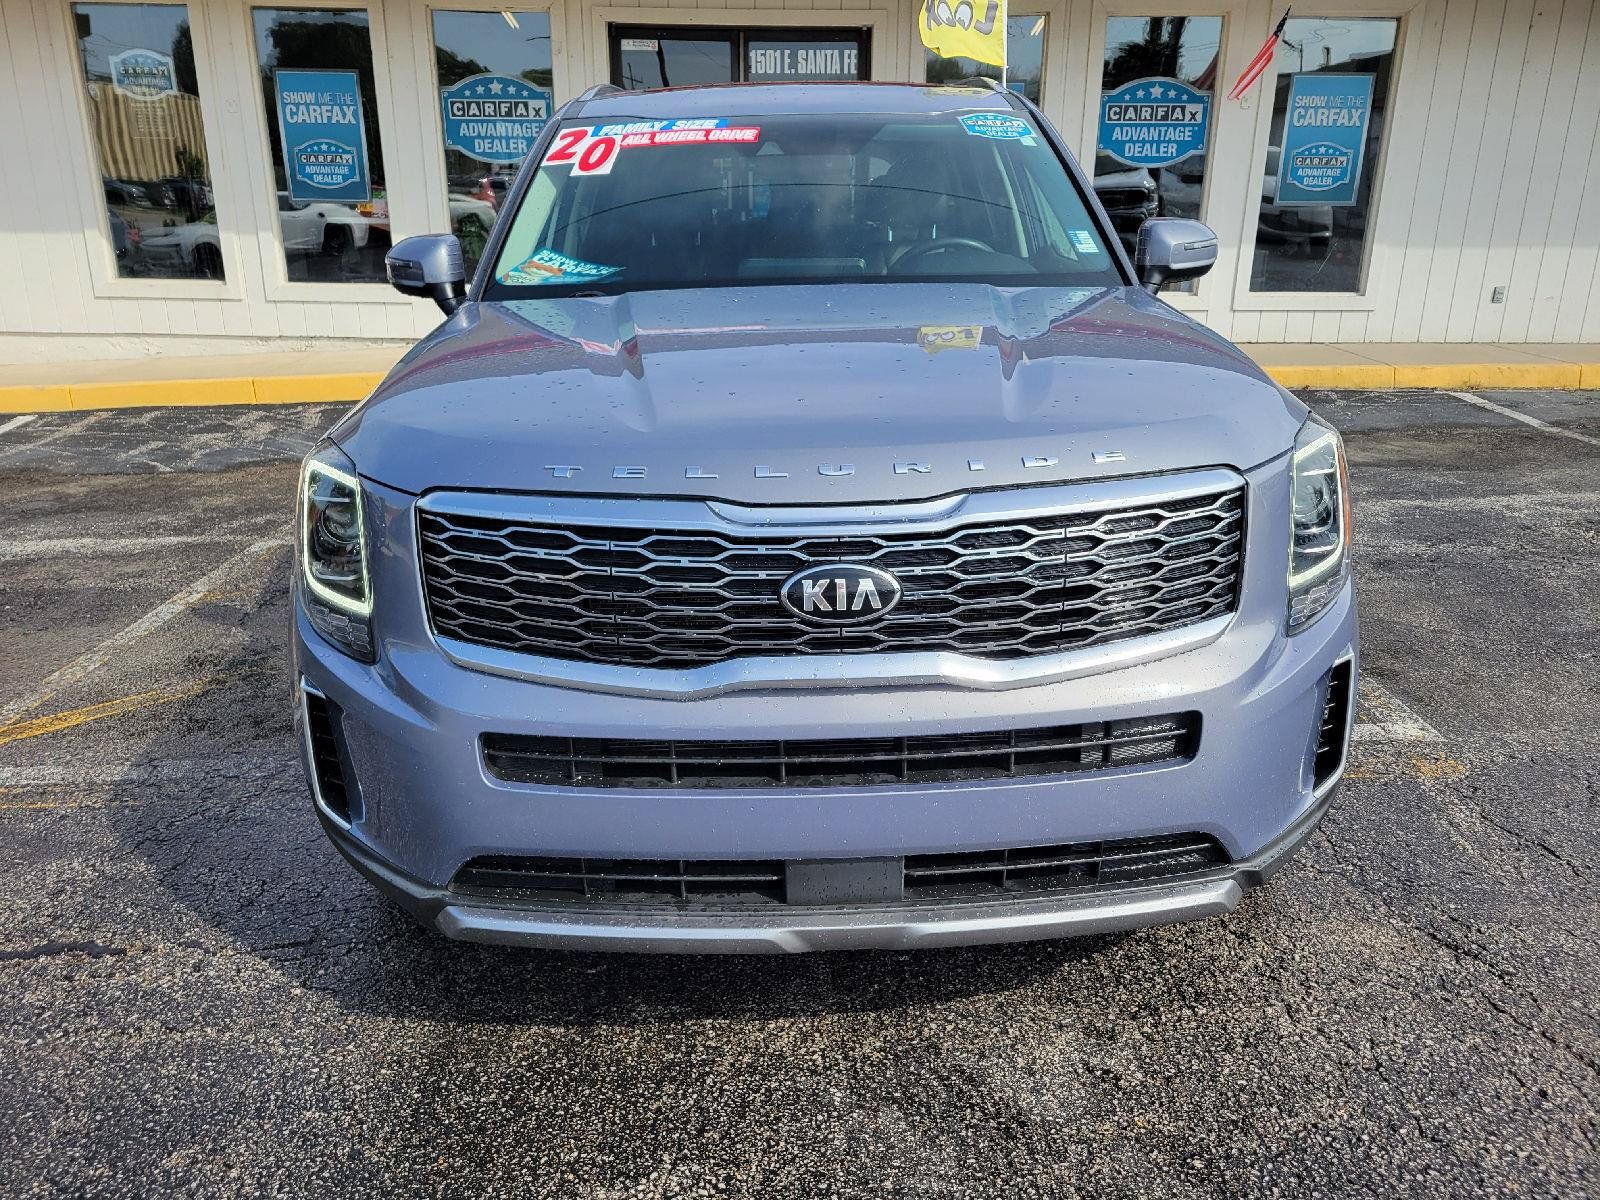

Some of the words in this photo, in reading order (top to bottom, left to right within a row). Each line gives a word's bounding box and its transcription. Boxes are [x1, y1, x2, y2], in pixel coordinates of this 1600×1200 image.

[749, 50, 781, 73] 1501
[784, 50, 795, 74] E.
[797, 50, 840, 74] SANTA
[843, 50, 857, 73] FE
[283, 91, 315, 104] SHOW
[318, 92, 333, 105] ME
[335, 92, 354, 105] THE
[1295, 95, 1327, 107] SHOW
[1329, 96, 1345, 107] ME
[1347, 95, 1365, 107] THE
[285, 105, 356, 124] CARFAX
[452, 101, 543, 118] CARFAX
[1108, 105, 1200, 122] CARFAX
[966, 119, 1026, 128] CARFAX
[1293, 108, 1362, 127] CARFAX
[460, 122, 540, 137] ADVANTAGE
[598, 120, 670, 136] FAMILY
[672, 119, 720, 131] SIZE
[975, 125, 1025, 133] ADVANTAGE
[1112, 126, 1193, 141] ADVANTAGE
[620, 133, 652, 146] ALL
[654, 129, 707, 143] WHEEL
[708, 128, 758, 141] DRIVE
[475, 139, 528, 153] DEALER
[1124, 143, 1178, 157] DEALER
[301, 154, 351, 164] CARFAX
[1296, 157, 1347, 167] CARFAX
[305, 165, 349, 175] ADVANTAGE
[1297, 168, 1342, 177] ADVANTAGE
[313, 174, 342, 183] DEALER
[1303, 177, 1333, 185] DEALER
[544, 450, 1127, 479] TELLURIDE
[801, 578, 882, 612] KIA
